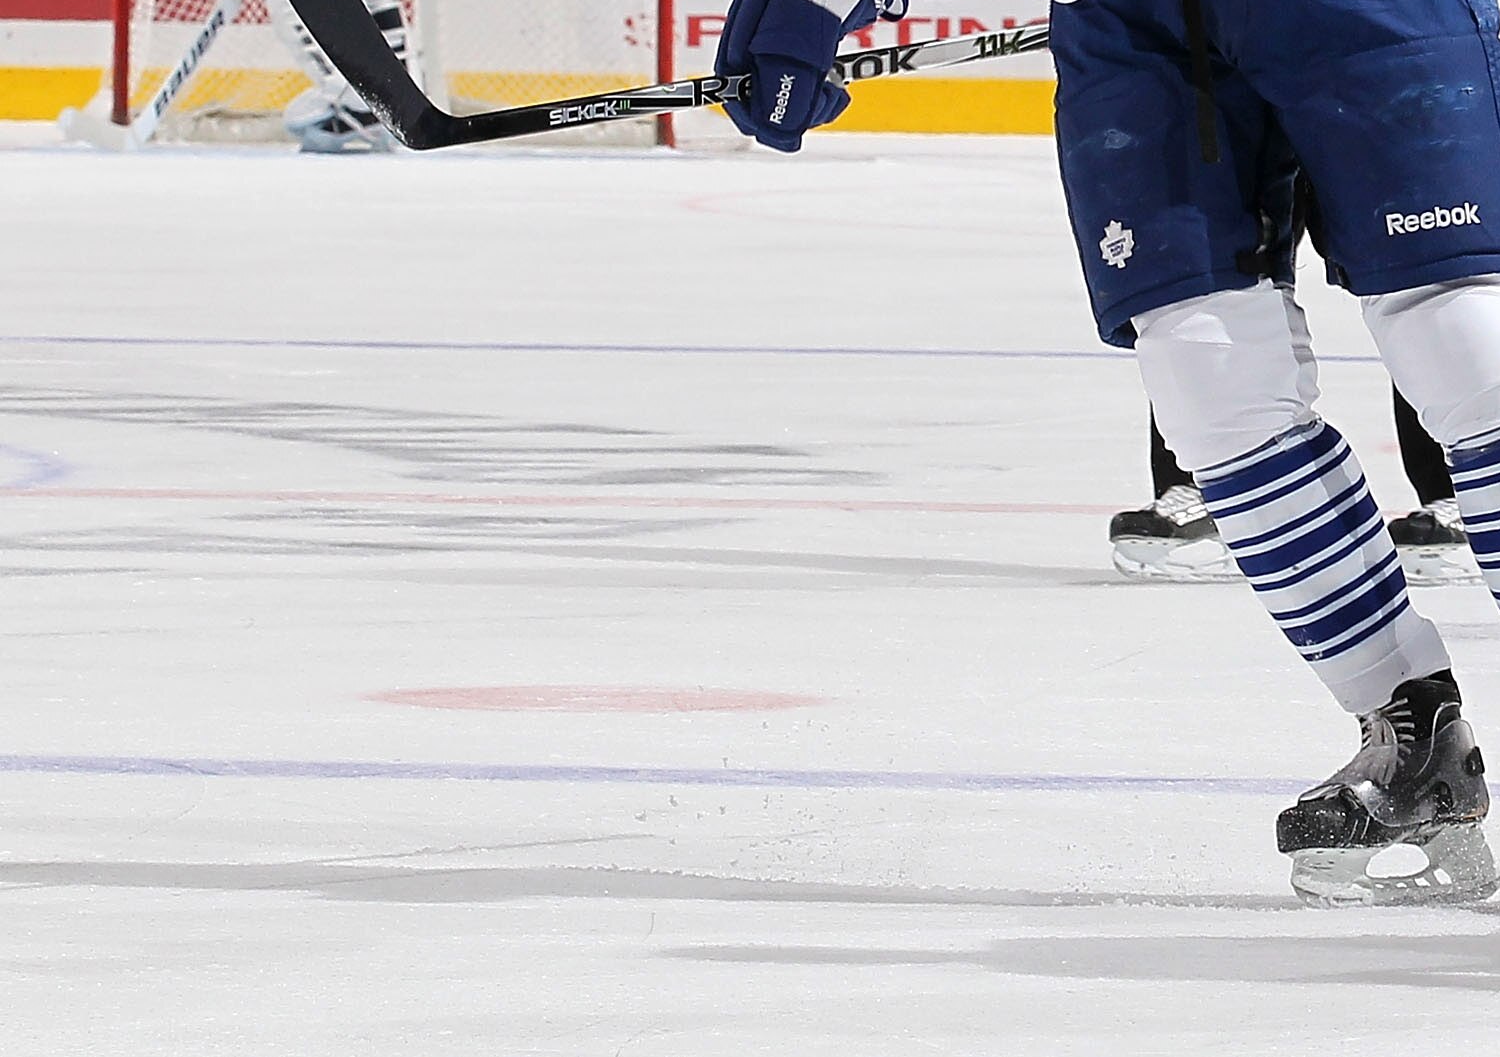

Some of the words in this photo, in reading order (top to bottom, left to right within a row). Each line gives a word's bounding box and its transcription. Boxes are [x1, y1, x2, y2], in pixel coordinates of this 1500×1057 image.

[549, 100, 617, 126] SICKICK
[769, 73, 796, 125] Reebok
[1385, 202, 1481, 236] Reebok
